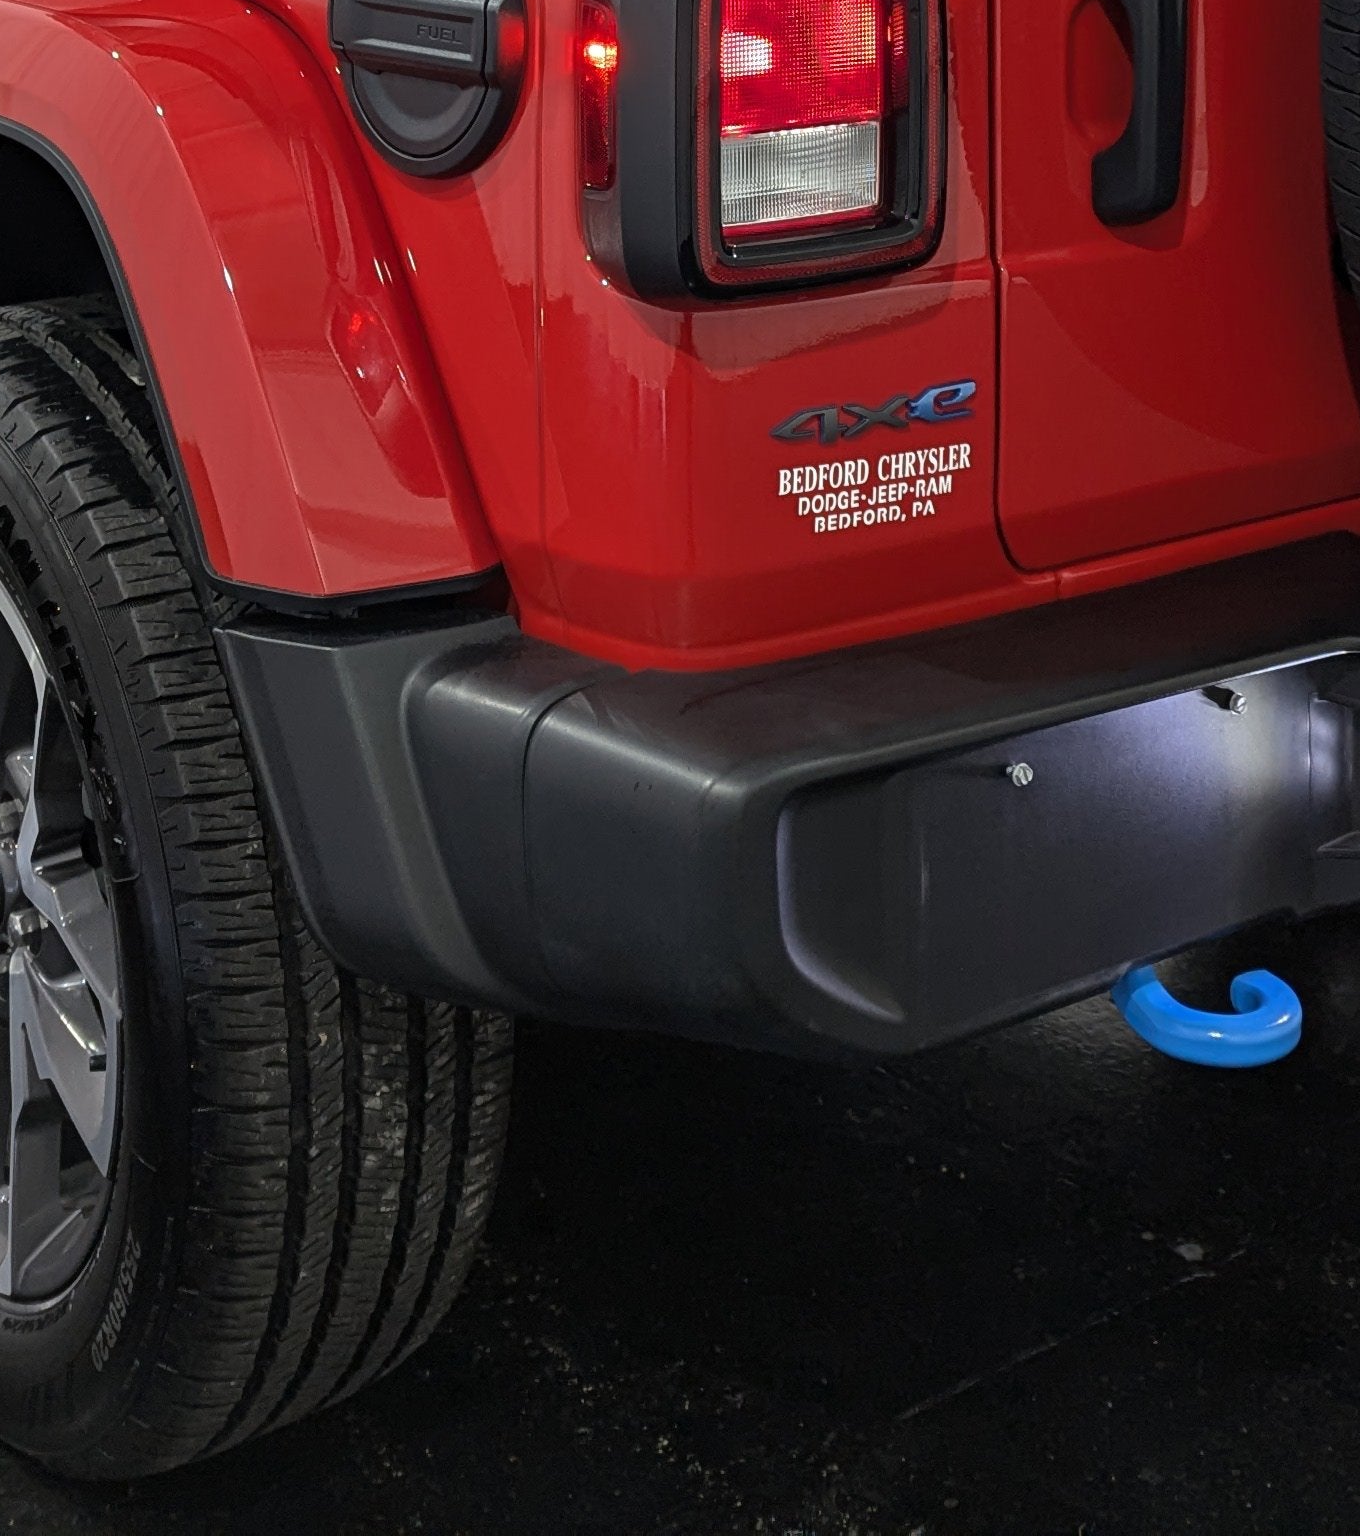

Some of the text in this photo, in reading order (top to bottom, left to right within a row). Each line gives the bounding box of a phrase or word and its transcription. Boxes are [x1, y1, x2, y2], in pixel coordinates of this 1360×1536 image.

[416, 23, 463, 45] FUEL
[778, 443, 971, 496] BEDFORD CHRYSLER
[814, 499, 935, 533] BEDFORD, PA
